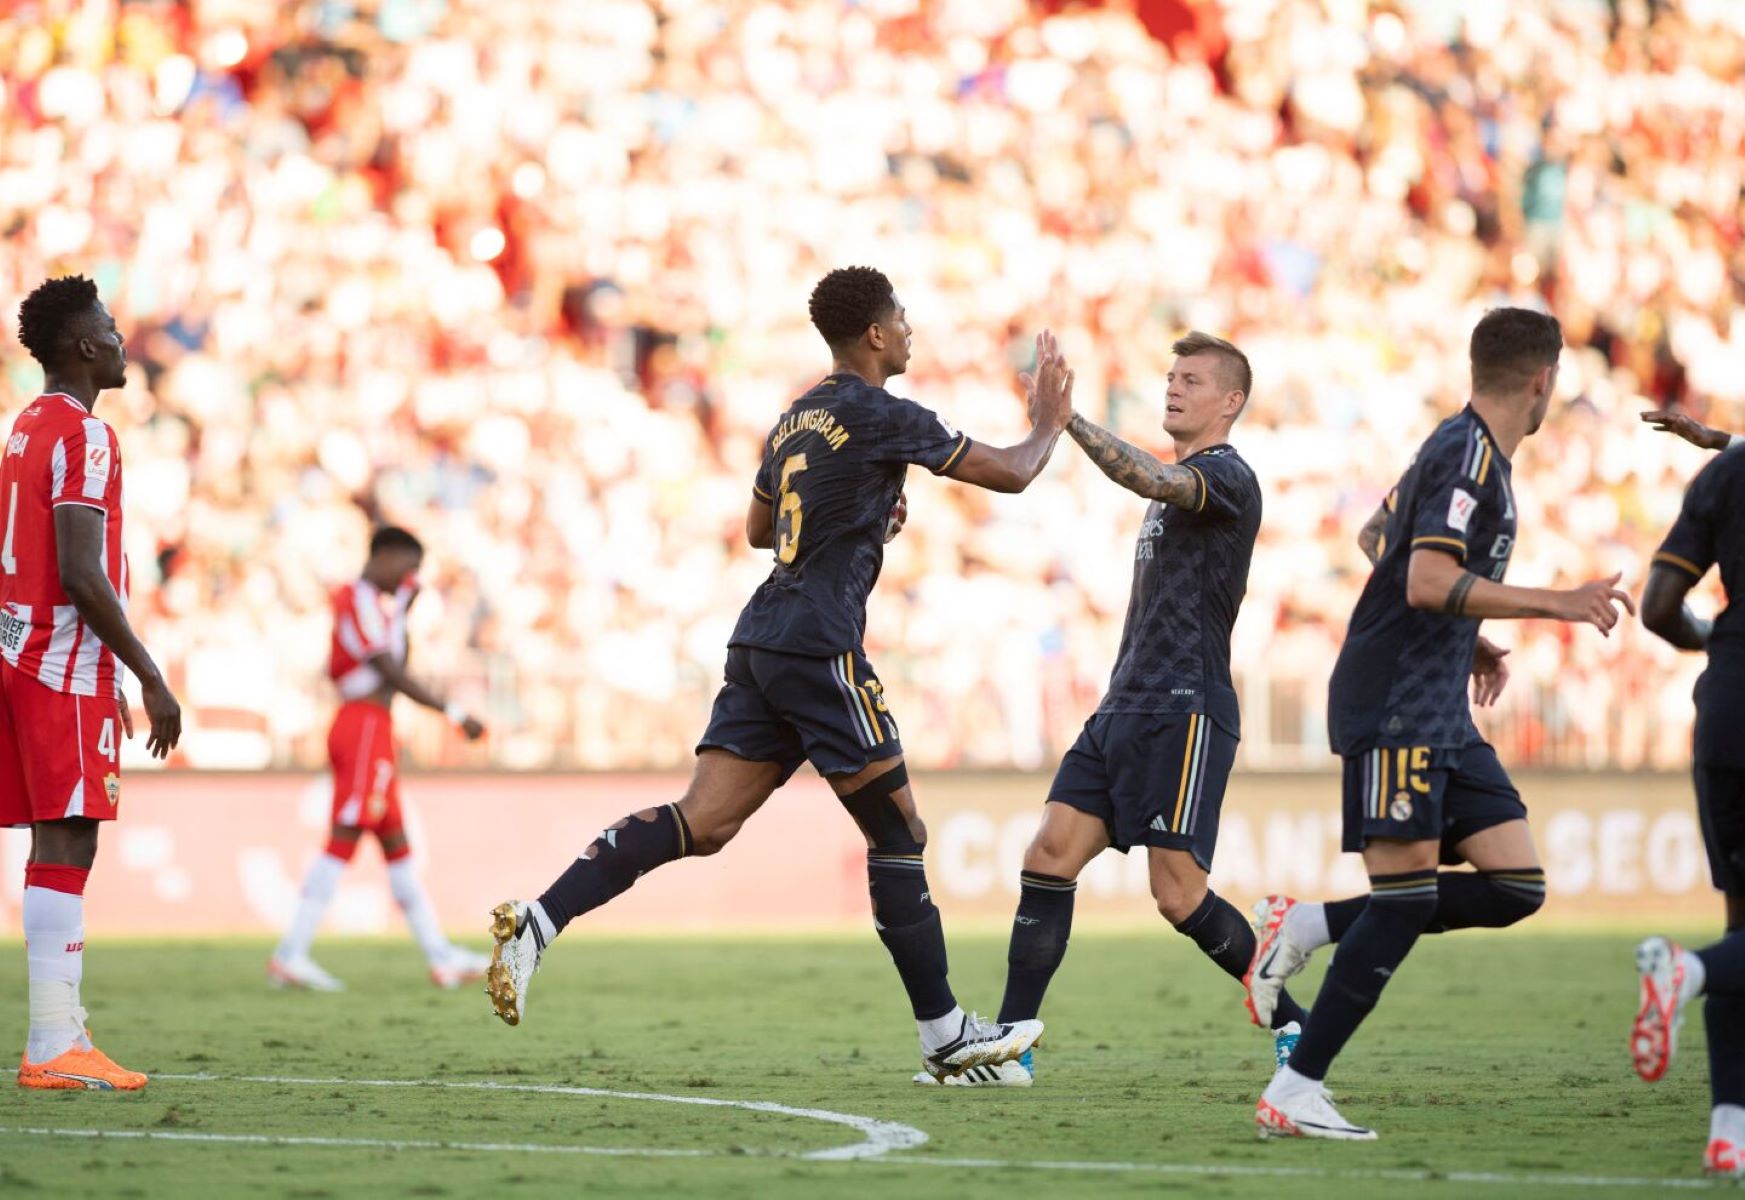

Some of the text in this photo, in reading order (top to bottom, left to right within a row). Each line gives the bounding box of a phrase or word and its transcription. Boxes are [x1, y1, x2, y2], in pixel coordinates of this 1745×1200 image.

[778, 453, 808, 566] 5
[97, 717, 116, 763] 4
[1397, 746, 1431, 793] 15
